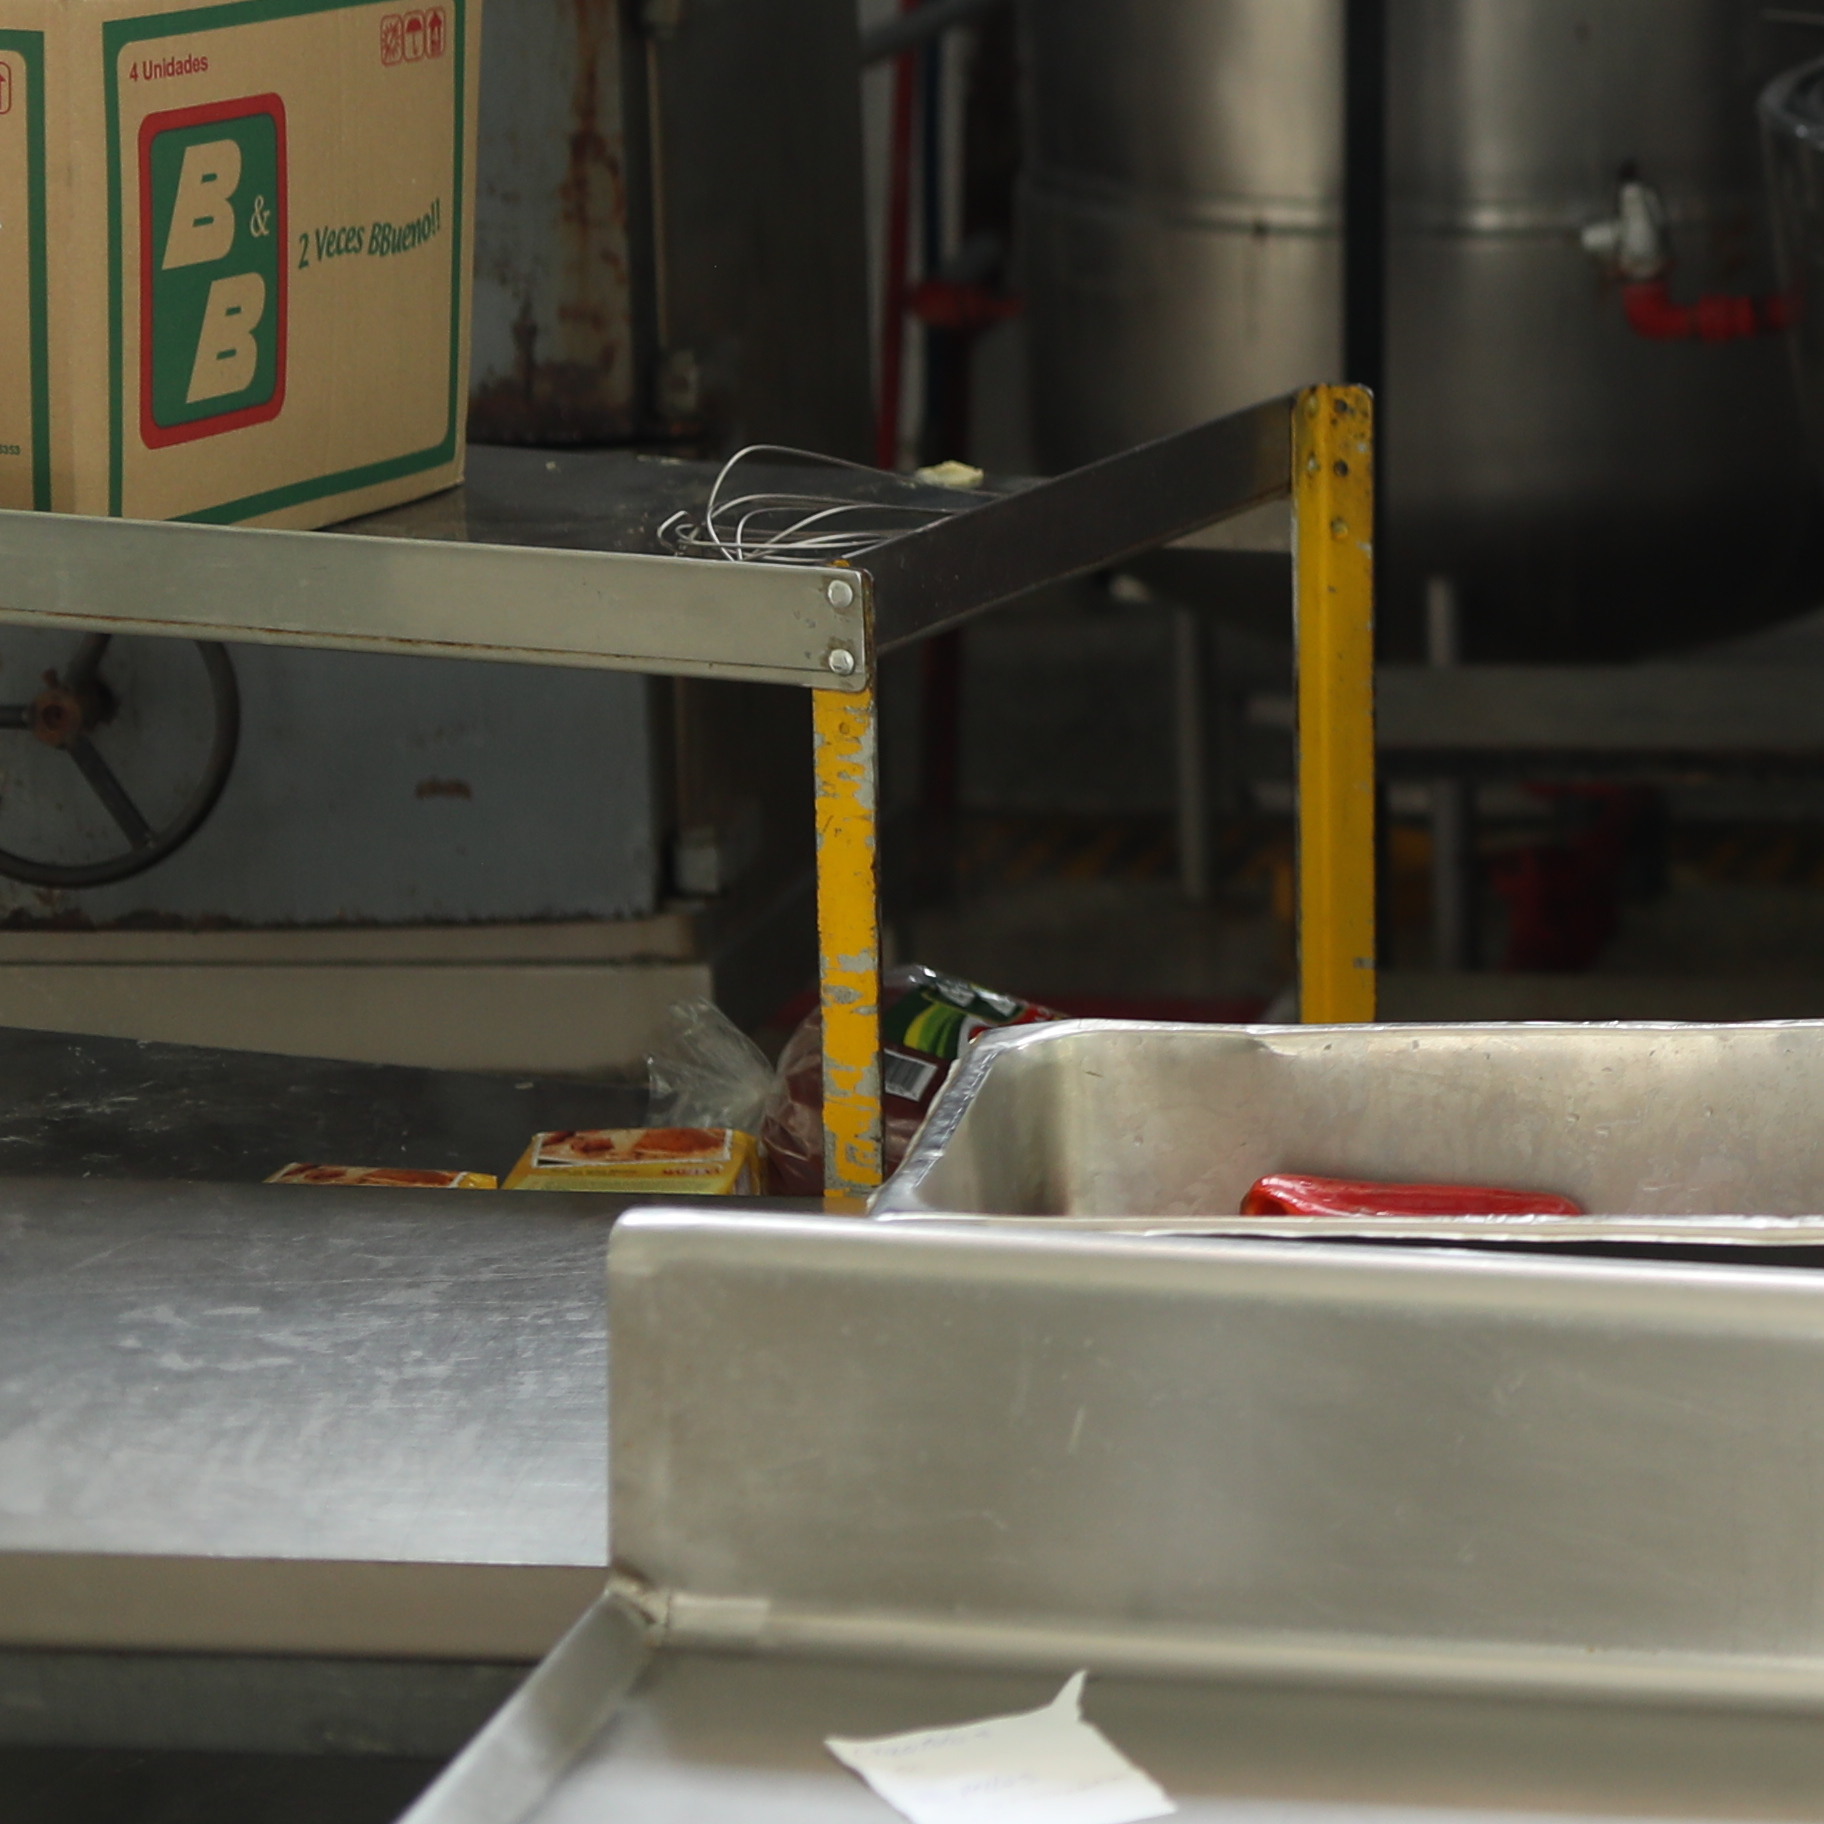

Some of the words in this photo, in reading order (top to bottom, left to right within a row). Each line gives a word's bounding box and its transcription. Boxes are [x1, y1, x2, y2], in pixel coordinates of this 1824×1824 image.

[129, 61, 139, 82] 4
[142, 53, 209, 81] Unidades
[161, 139, 242, 270] B
[250, 195, 271, 238] &
[298, 232, 310, 270] 2
[315, 226, 365, 262] Veces
[367, 197, 440, 257] BBueno!!
[185, 272, 266, 404] B
